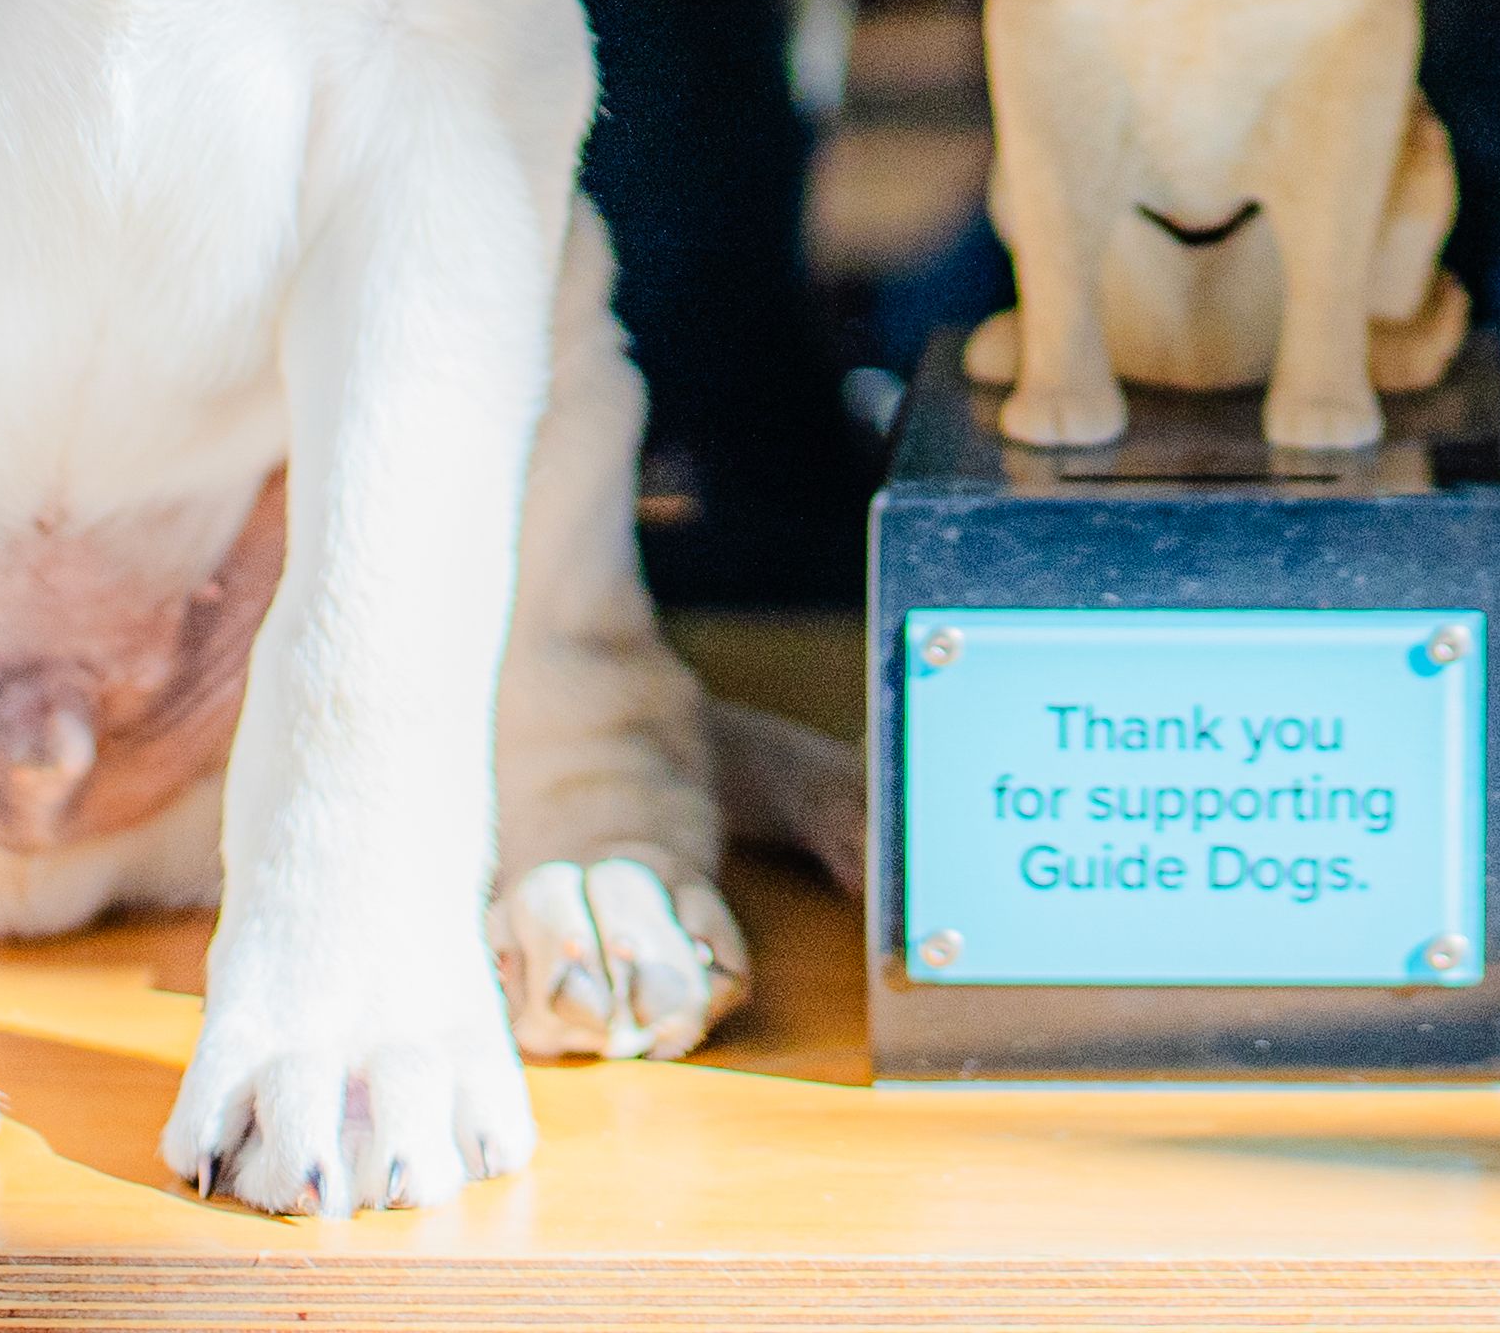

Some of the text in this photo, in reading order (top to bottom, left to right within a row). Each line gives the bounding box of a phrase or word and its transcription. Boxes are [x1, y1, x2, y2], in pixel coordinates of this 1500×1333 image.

[1045, 703, 1343, 765] Thank you
[992, 773, 1396, 835] for supporting
[1018, 843, 1369, 905] Guide Dogs.
